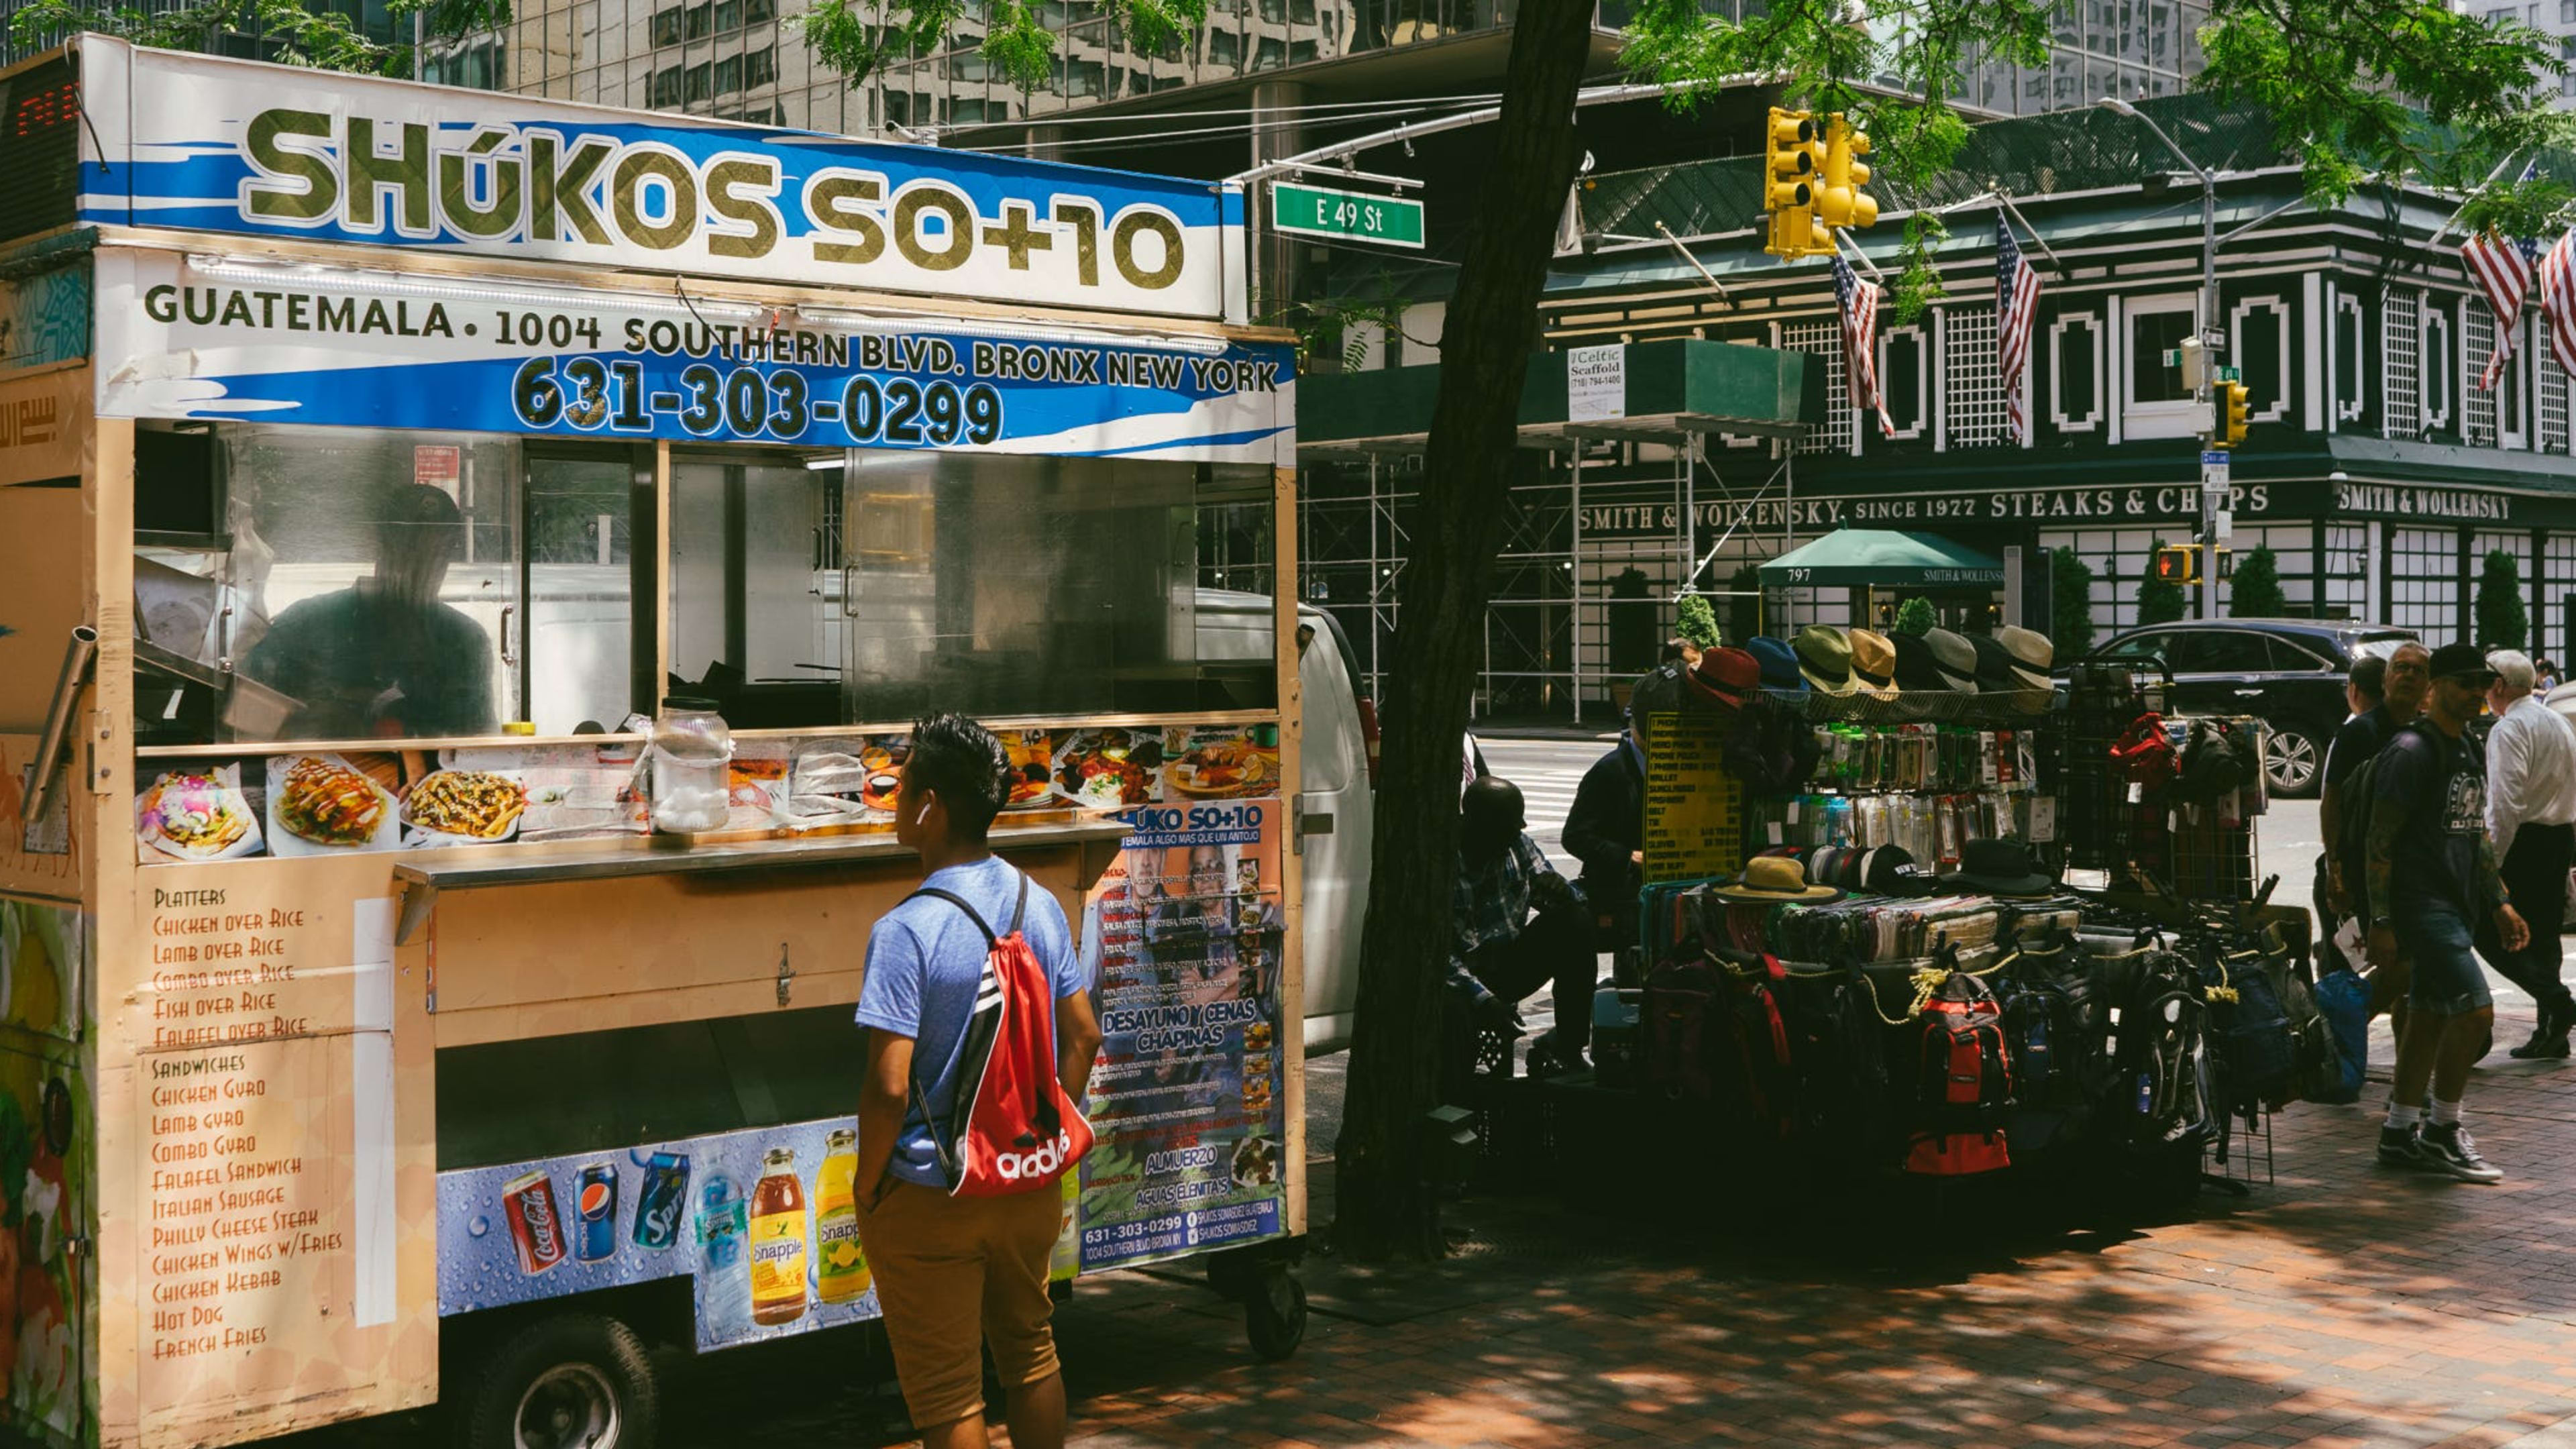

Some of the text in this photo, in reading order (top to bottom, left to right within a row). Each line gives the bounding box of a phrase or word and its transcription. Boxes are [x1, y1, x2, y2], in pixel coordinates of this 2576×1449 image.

[244, 107, 1185, 291] SHÚKOS SO+10
[1317, 199, 1383, 232] E 49 St
[144, 284, 1280, 394] GUATEMALA 1004 SOUTHERN BLVD. BRONX NEW YORK
[1571, 362, 1620, 376] Scaffold
[1578, 350, 1619, 363] Celtic
[513, 355, 1004, 447] 631-303-0299
[1578, 498, 1975, 530] SMITH & WOLLENSKY SINCE 1972
[1990, 490, 2114, 518] STEAKS
[2125, 488, 2145, 515] &
[2338, 484, 2512, 521] SMITH & WOLLENSKY
[1788, 568, 1811, 582] 797
[1155, 834, 1177, 845] ALGO
[1178, 833, 1197, 844] MAS
[1197, 832, 1214, 843] QUE
[1215, 832, 1228, 842] UN
[1228, 830, 1259, 841] ANTOJO
[1102, 1005, 1190, 1036] DESAYUNO
[1190, 1004, 1203, 1024] Y
[1204, 998, 1257, 1024] CENAS
[1136, 1025, 1225, 1054] CHAPINAS
[1145, 1144, 1218, 1175] ALMUERZO
[1135, 1185, 1175, 1210] AGUAS
[820, 1222, 859, 1243] Snapp
[1085, 1216, 1182, 1244] 631-303-0299
[753, 1238, 803, 1263] Snapple
[1085, 1246, 1102, 1260] 1004
[1103, 1240, 1135, 1258] SOUTHERN
